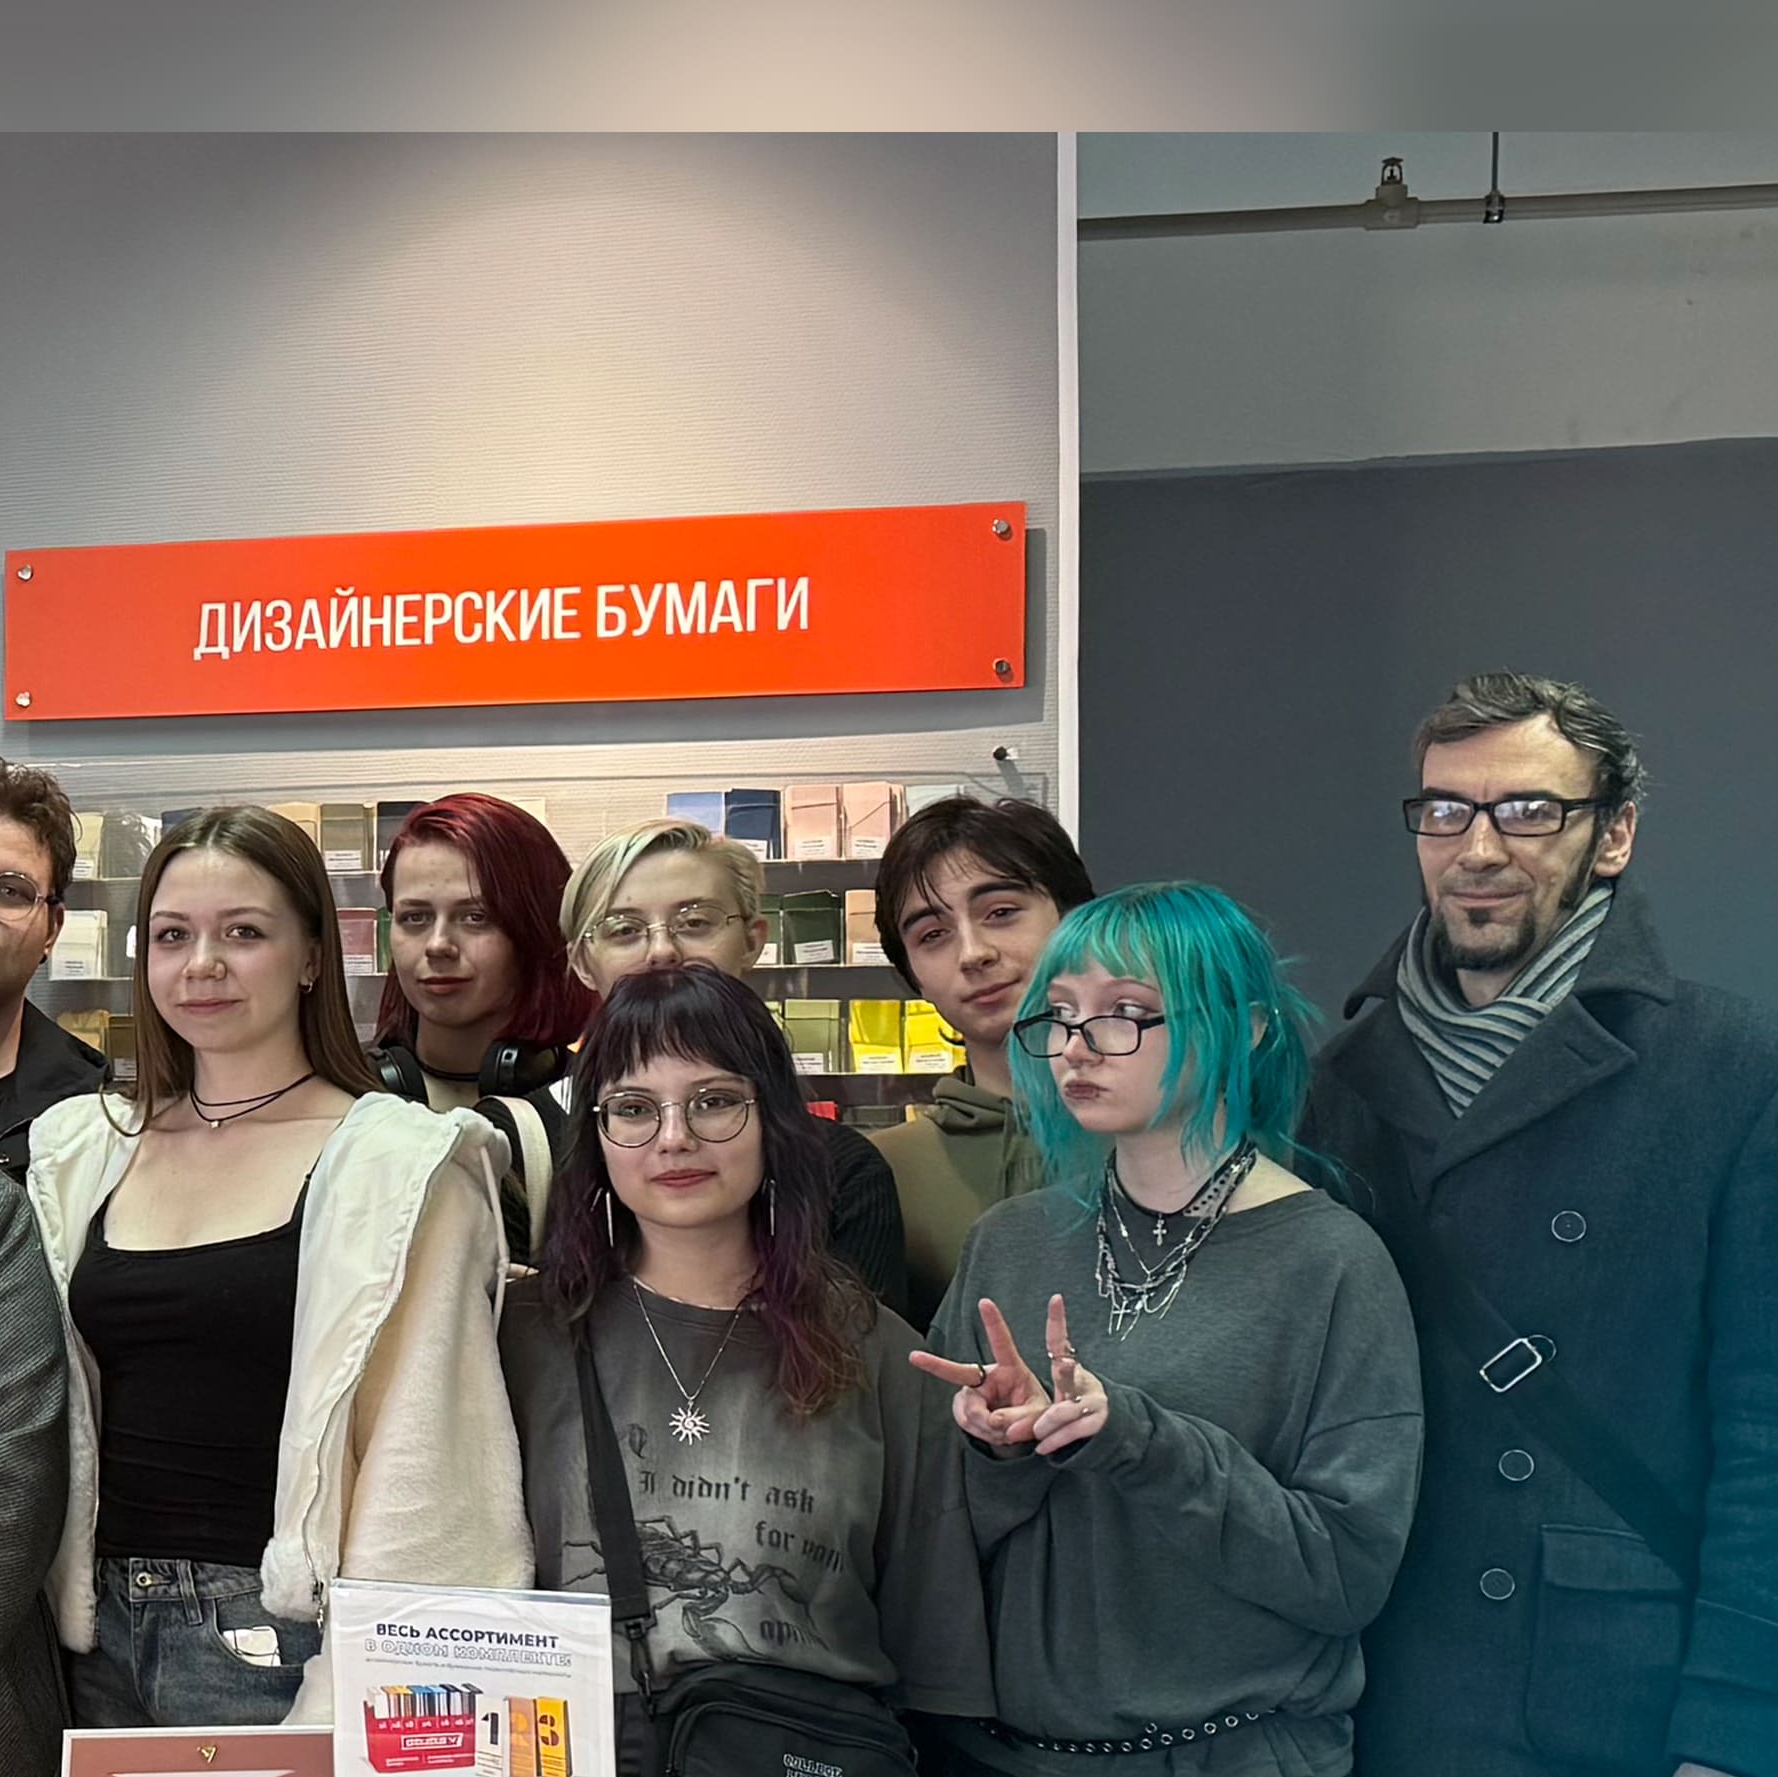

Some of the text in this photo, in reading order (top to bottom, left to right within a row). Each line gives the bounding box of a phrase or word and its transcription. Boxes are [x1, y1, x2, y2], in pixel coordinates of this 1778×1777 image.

[193, 576, 810, 661] ДИЗАЙНЕРСКИЕ БУМАГИ
[672, 1474, 751, 1501] didn't
[765, 1486, 814, 1514] ask
[756, 1519, 795, 1553] for
[376, 1623, 559, 1648] ВЕСЬ АССОРТИМЕНТ
